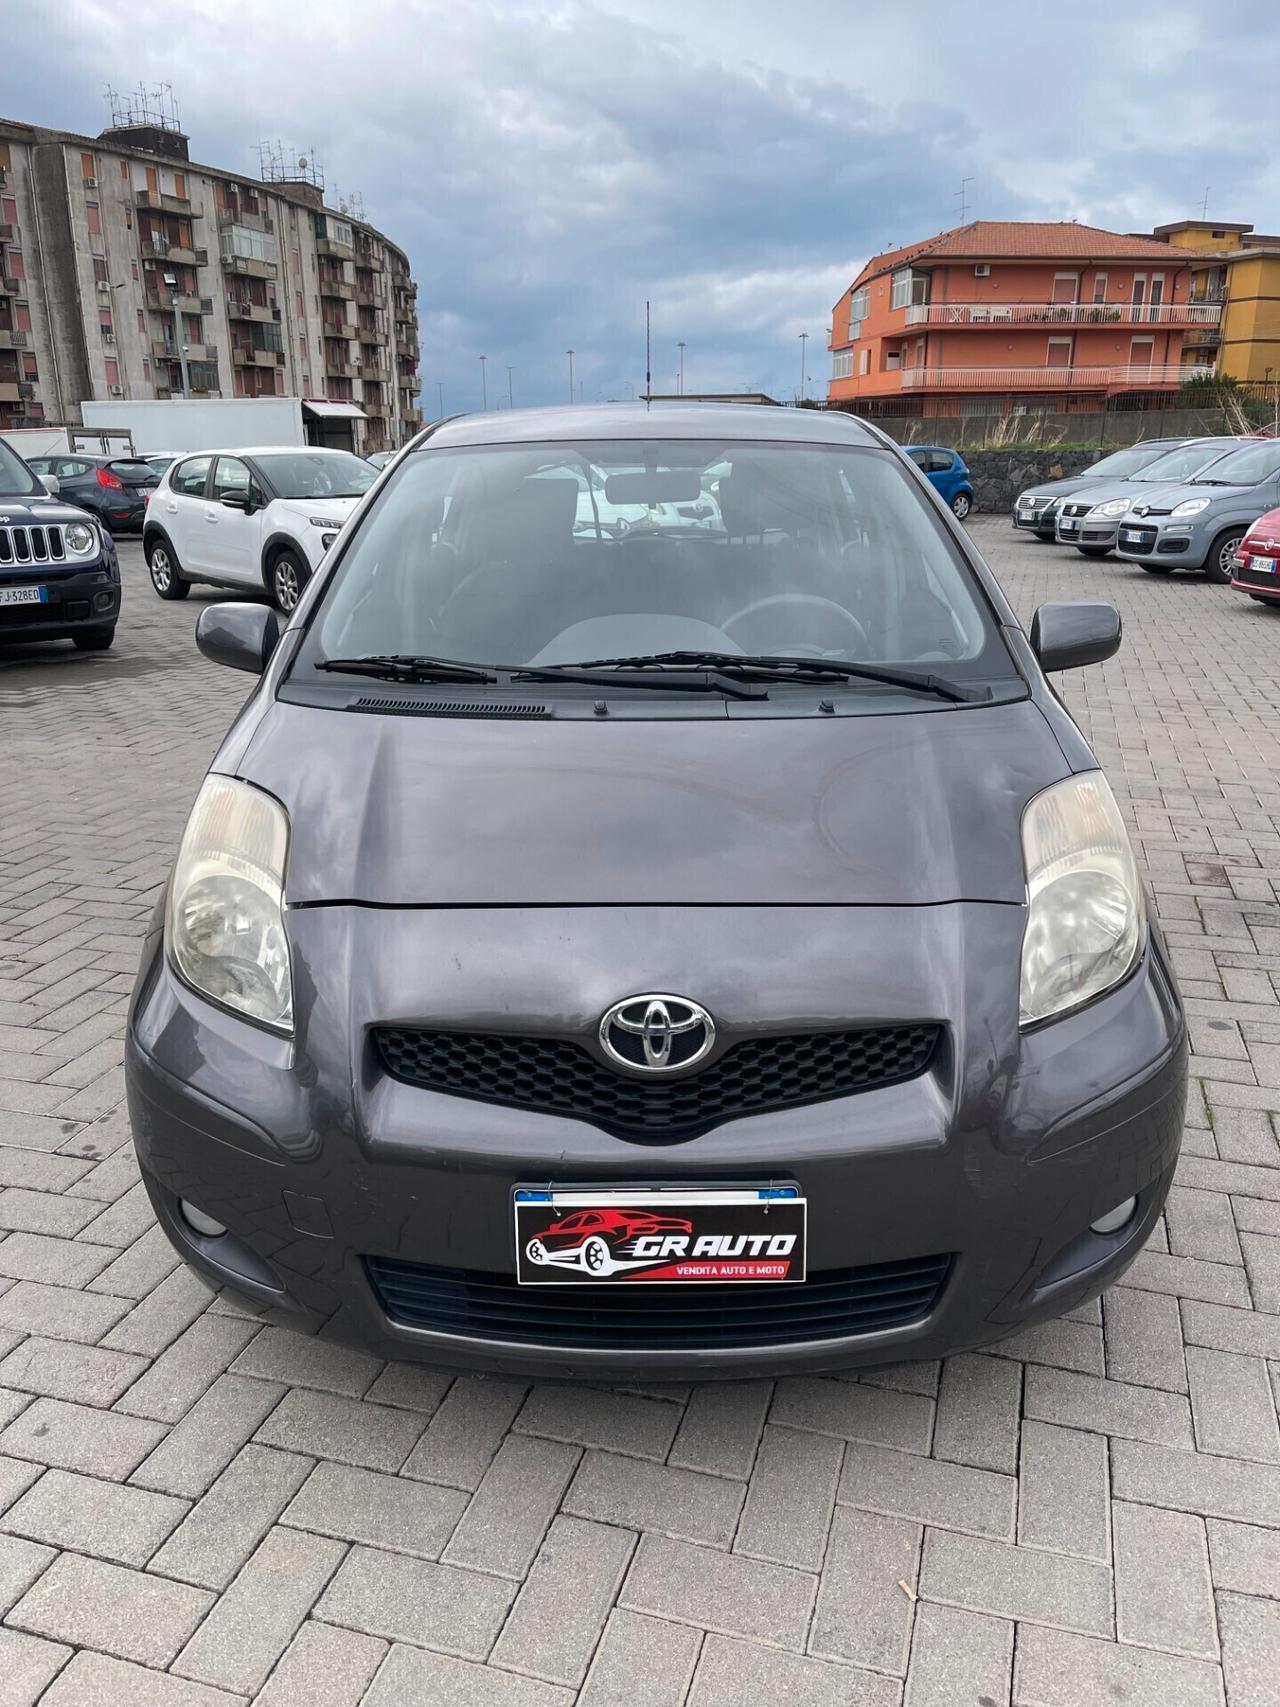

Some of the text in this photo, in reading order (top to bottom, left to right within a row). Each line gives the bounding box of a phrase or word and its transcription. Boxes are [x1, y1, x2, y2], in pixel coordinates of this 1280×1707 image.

[632, 1234, 797, 1257] GR AUTO
[676, 1265, 785, 1275] VENDITA AUTO E MOTO
